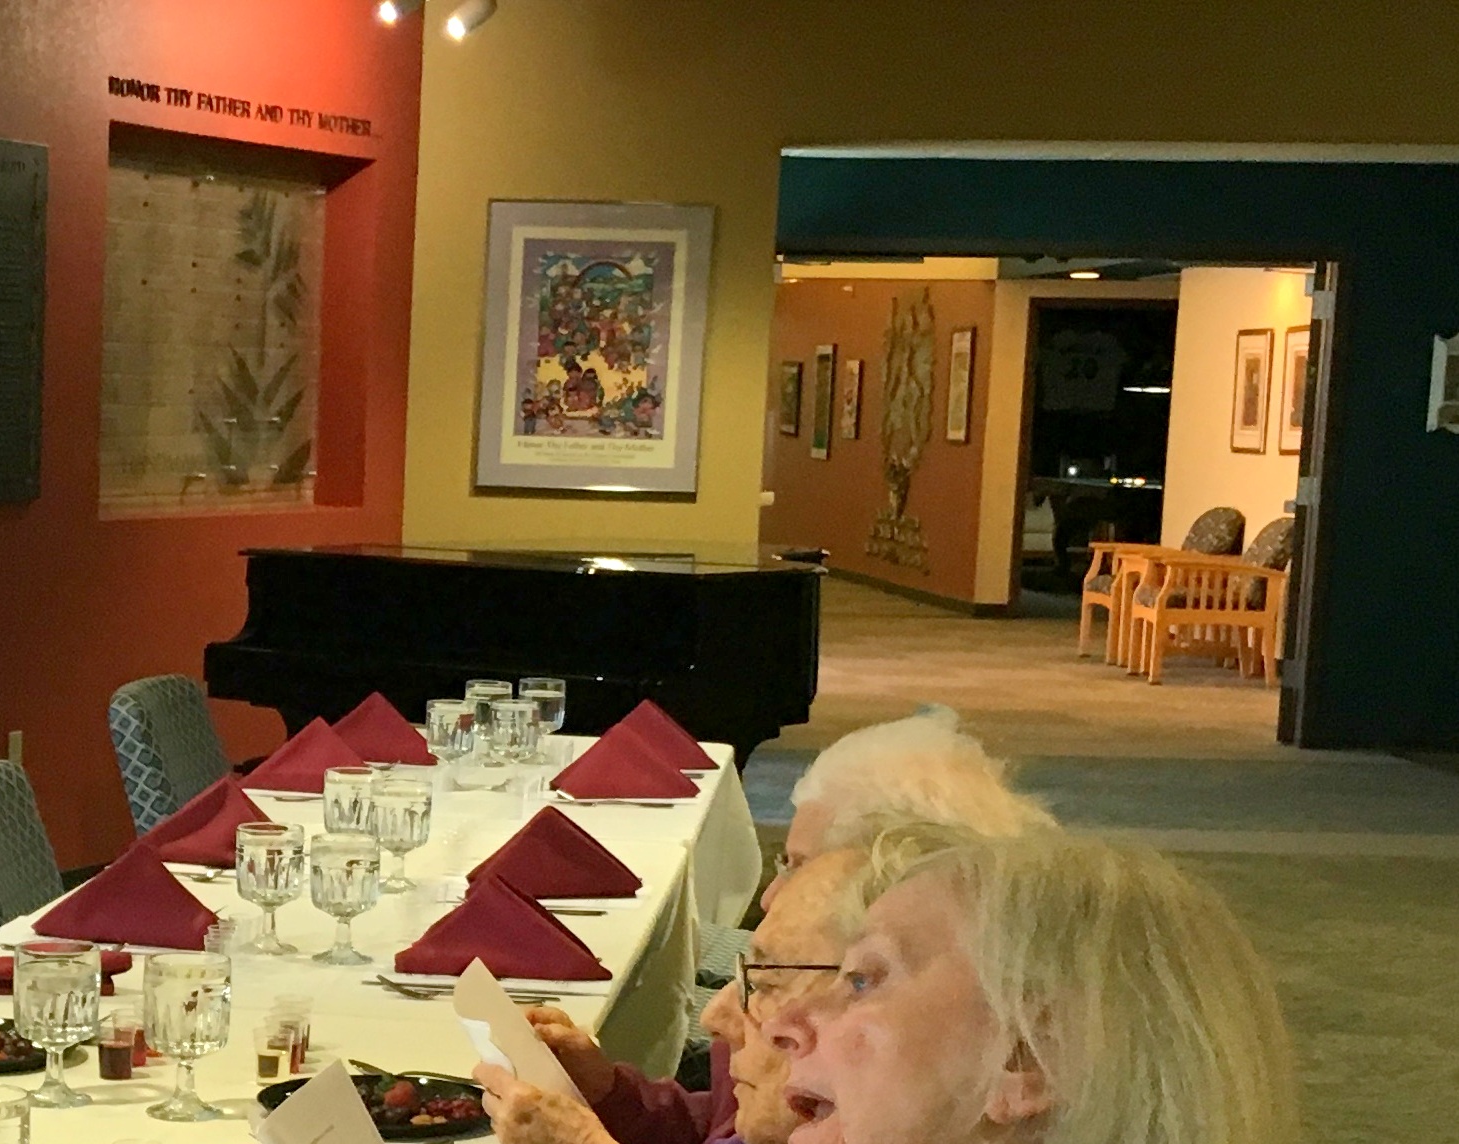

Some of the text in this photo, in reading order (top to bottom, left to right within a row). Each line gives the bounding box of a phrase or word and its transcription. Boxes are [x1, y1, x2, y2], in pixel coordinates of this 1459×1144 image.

[108, 75, 161, 104] HONOR
[164, 87, 193, 108] THY
[197, 92, 251, 119] FATHER
[255, 103, 283, 124] AND
[287, 107, 315, 128] THY
